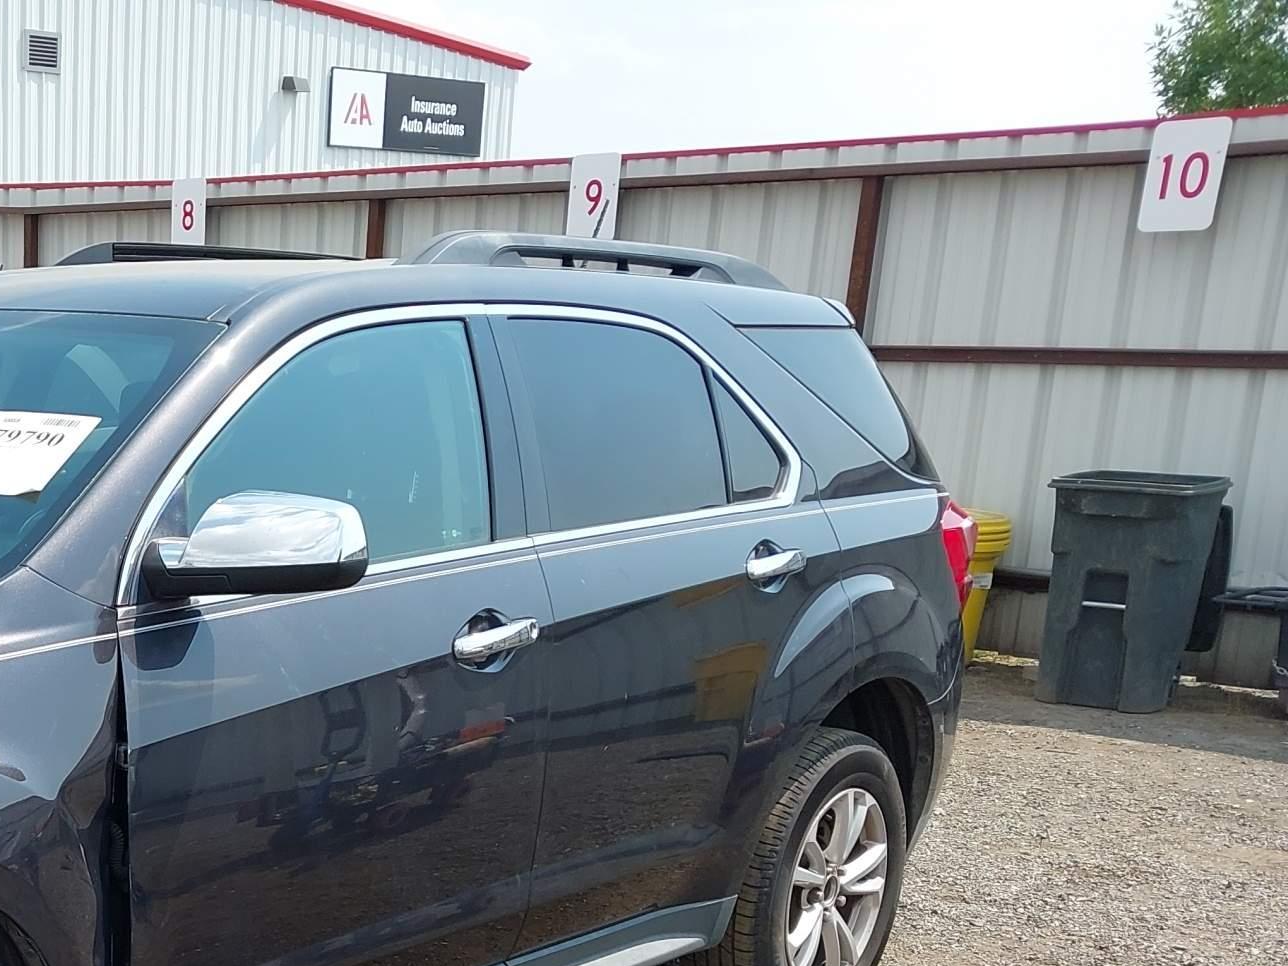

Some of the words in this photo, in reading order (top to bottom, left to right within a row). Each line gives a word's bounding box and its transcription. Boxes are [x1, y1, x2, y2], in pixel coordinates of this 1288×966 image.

[410, 95, 457, 116] Insurance
[400, 115, 423, 134] Auto
[424, 117, 465, 137] Auctions
[1158, 151, 1210, 201] 10
[585, 179, 603, 216] 9
[181, 199, 194, 231] 8
